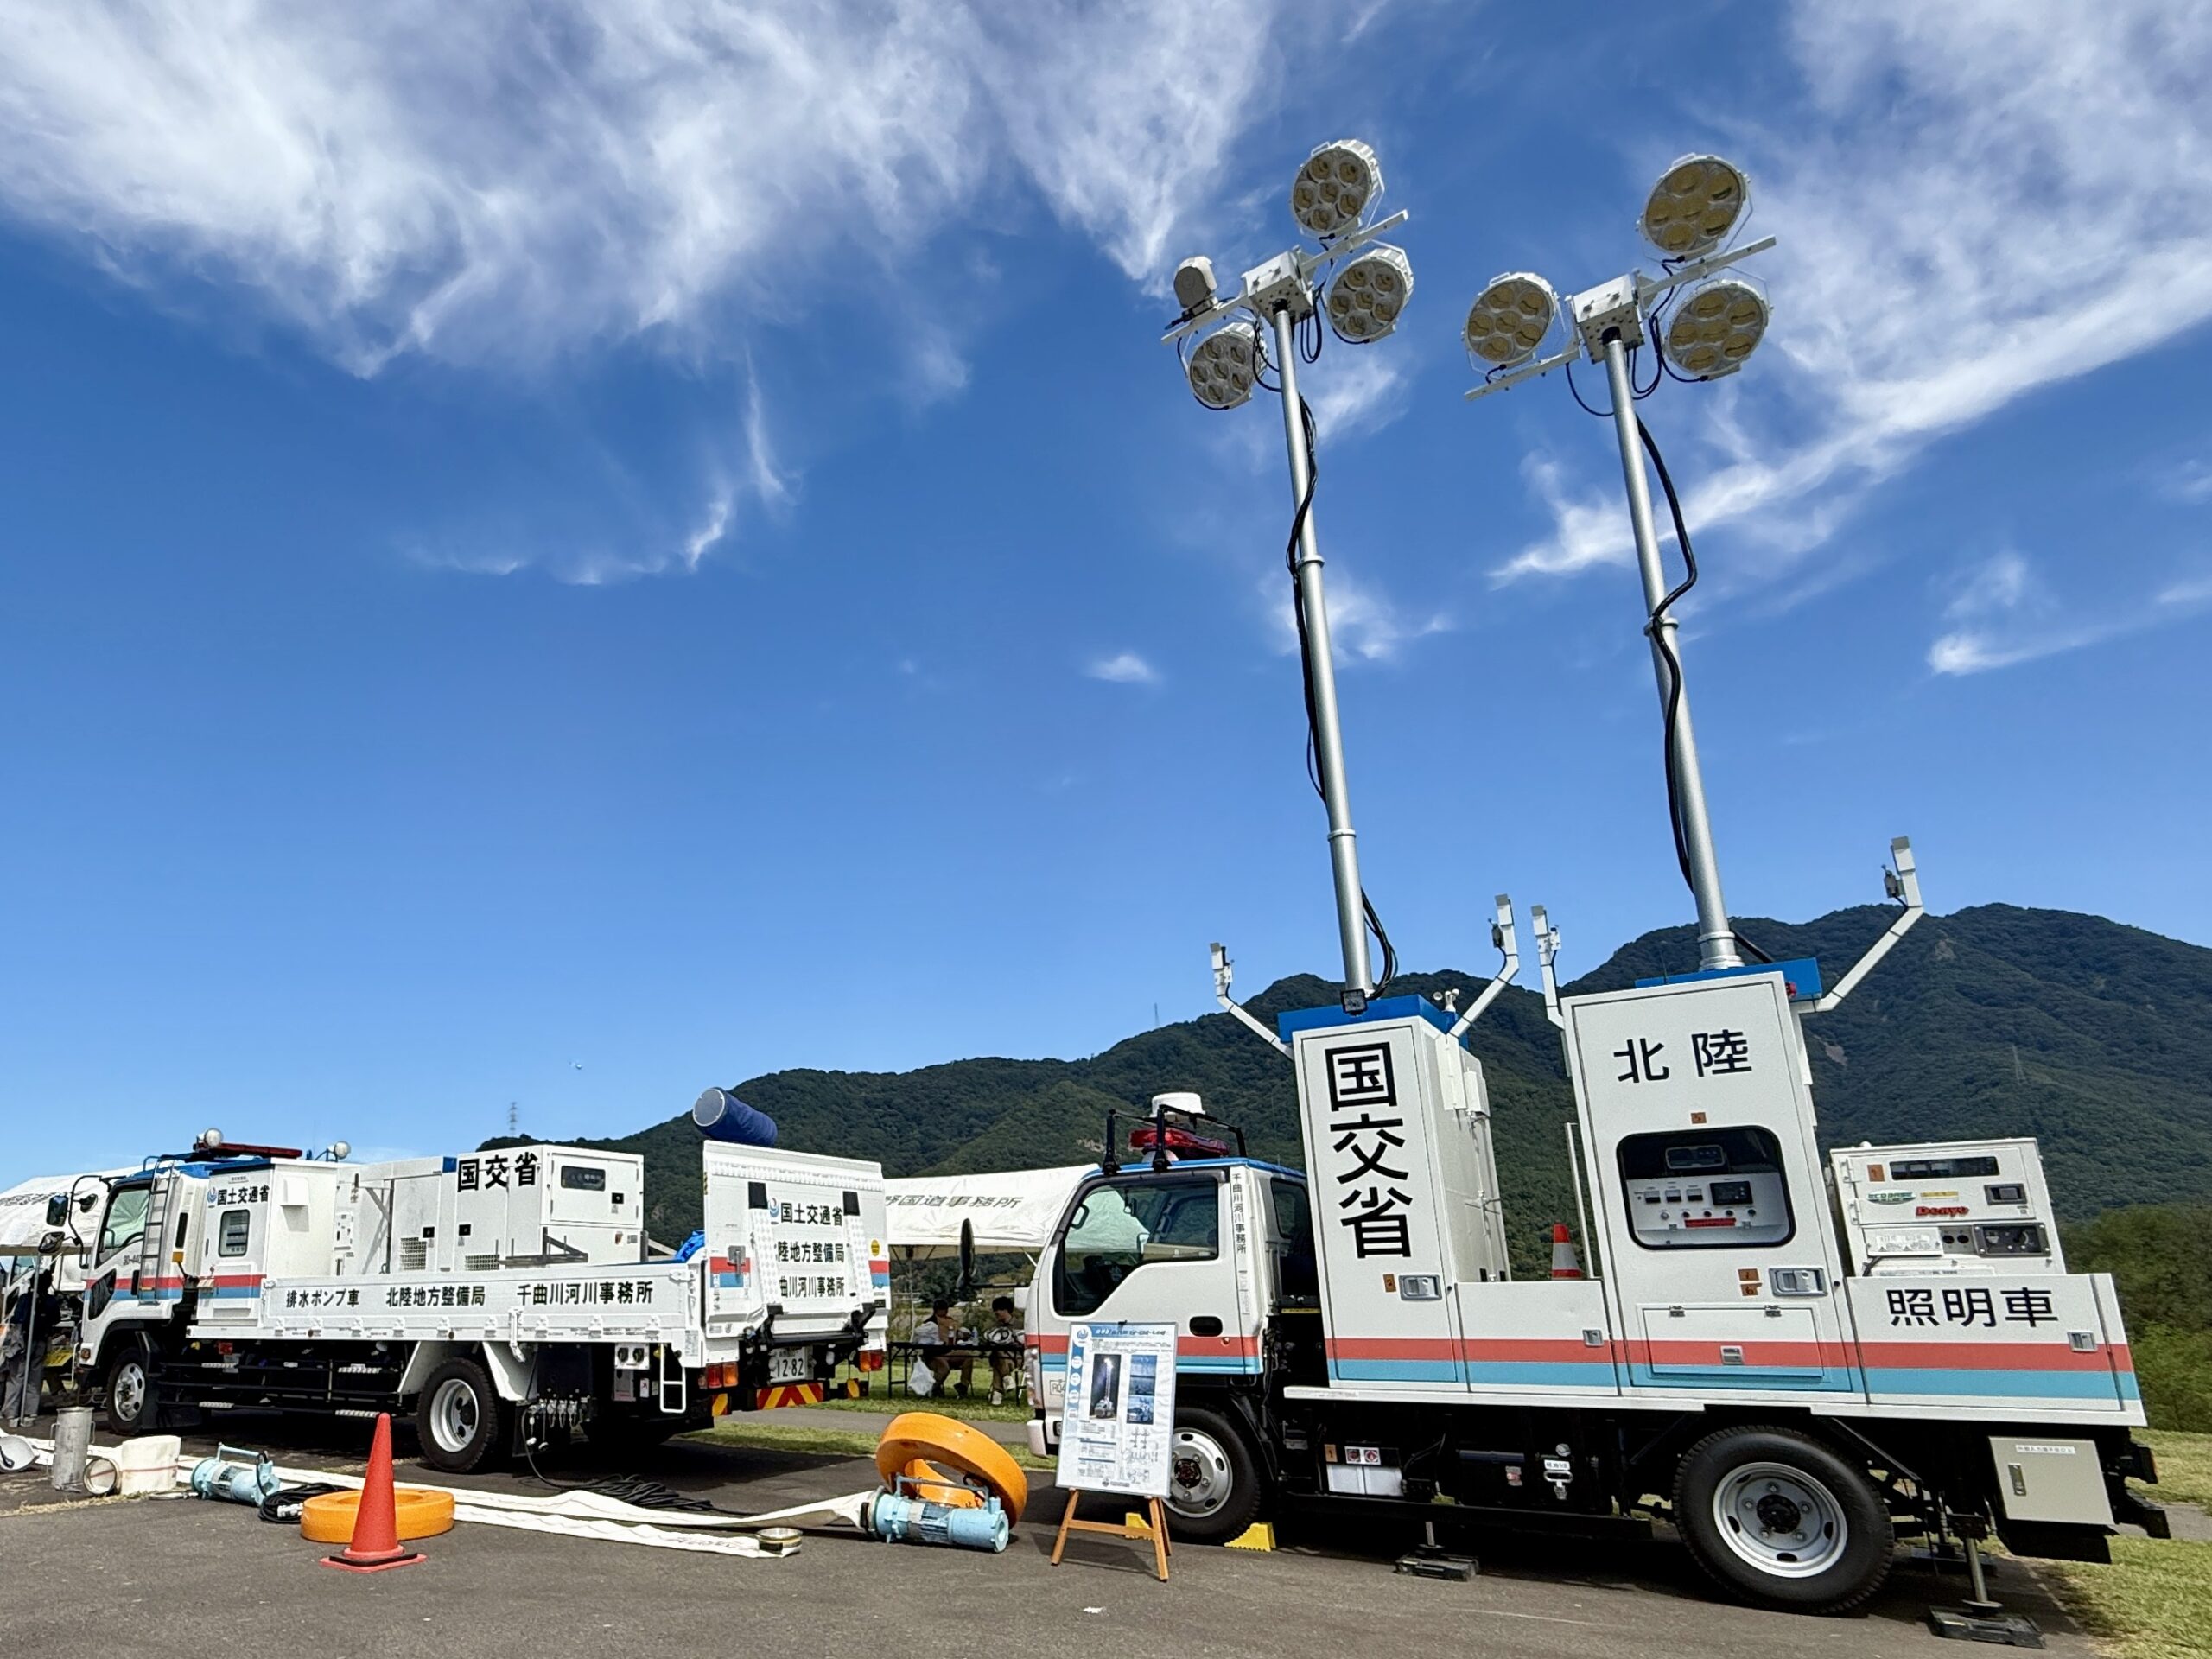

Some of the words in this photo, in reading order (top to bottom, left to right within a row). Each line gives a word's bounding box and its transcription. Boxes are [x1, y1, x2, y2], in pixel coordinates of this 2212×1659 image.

[1613, 1029, 1752, 1084] 北陸
[1325, 1041, 1413, 1259] 国交省
[458, 1152, 538, 1192] 国交省
[217, 1185, 270, 1205] 国土交通省
[1916, 1205, 1969, 1217] Denyo
[781, 1202, 842, 1226] 国土交通省
[1232, 1173, 1247, 1254] 千曲川河川事務所
[774, 1241, 844, 1263] 陸地方整備局
[286, 1289, 359, 1308] 排水ポンプ車
[386, 1286, 485, 1307] 北陸地方整備局
[517, 1281, 653, 1306] 千曲川河川事務所
[1886, 1287, 2059, 1327] 照明車
